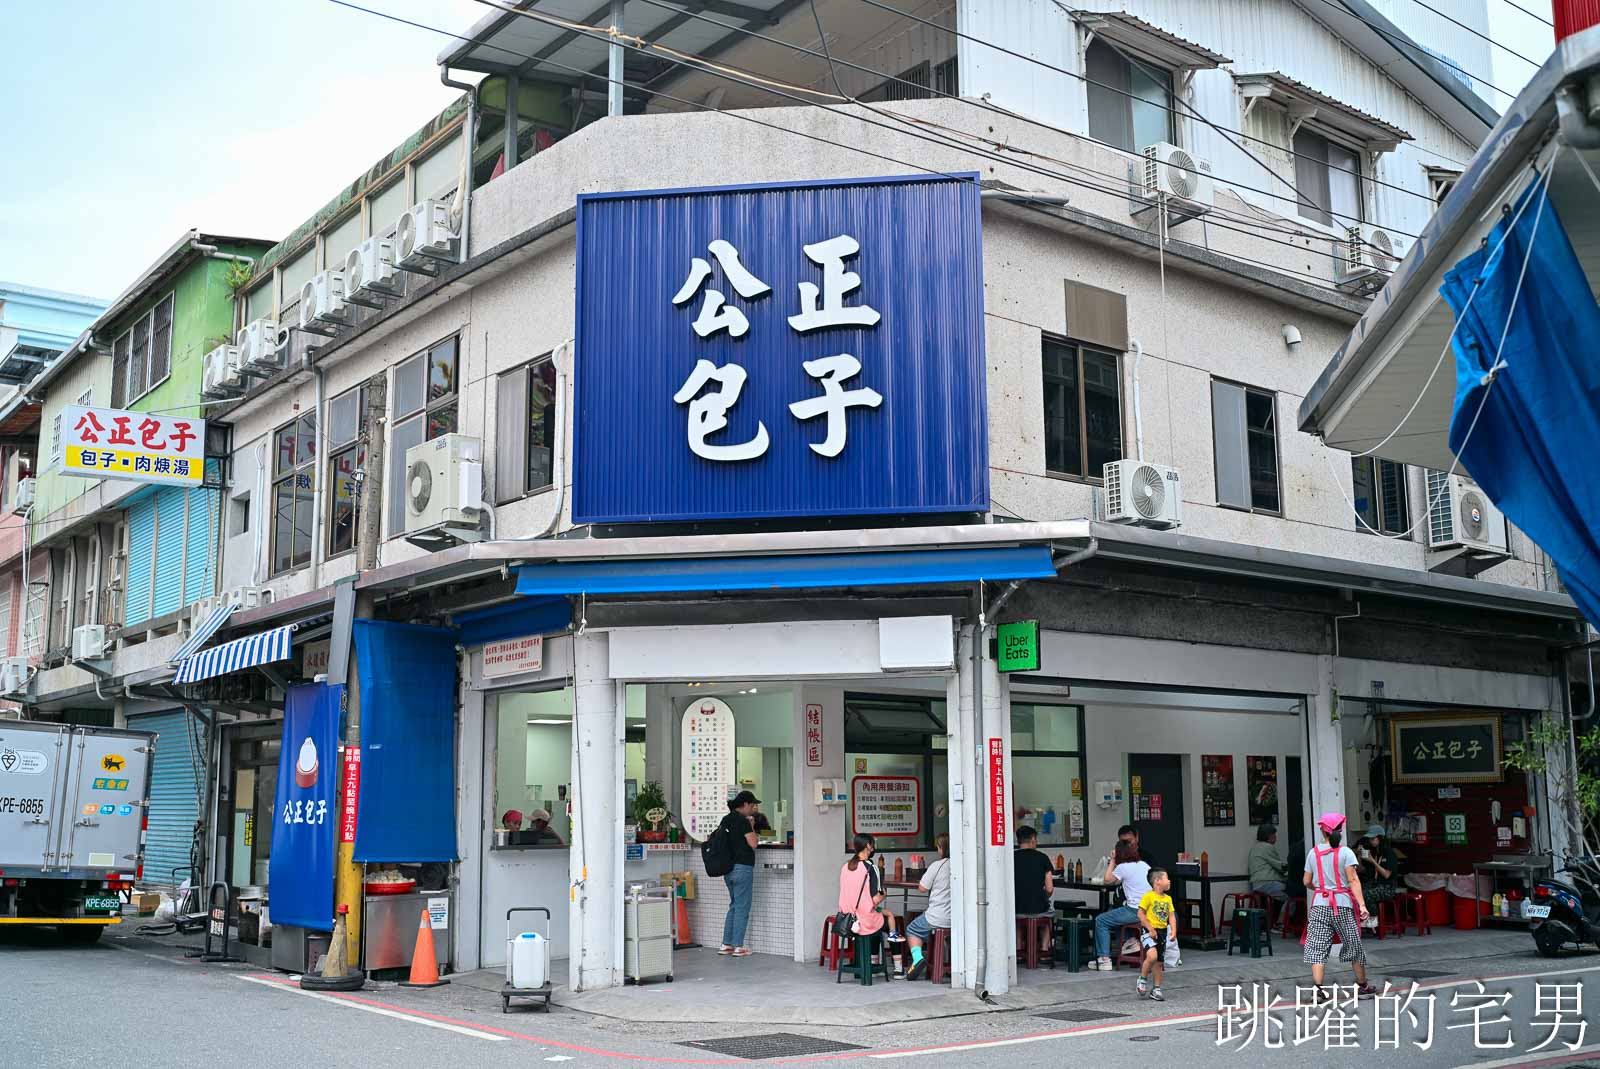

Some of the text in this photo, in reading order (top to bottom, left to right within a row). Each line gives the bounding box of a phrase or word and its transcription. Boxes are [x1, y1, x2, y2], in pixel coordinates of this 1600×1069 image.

[672, 234, 881, 337] 公正
[673, 353, 883, 461] 包子
[74, 411, 197, 452] 公正包子
[1005, 634, 1028, 647] Uber
[1005, 647, 1029, 660] Eats
[807, 708, 821, 762] 結帳區
[1413, 740, 1483, 760] 公正包子
[283, 800, 327, 824] 公正包子
